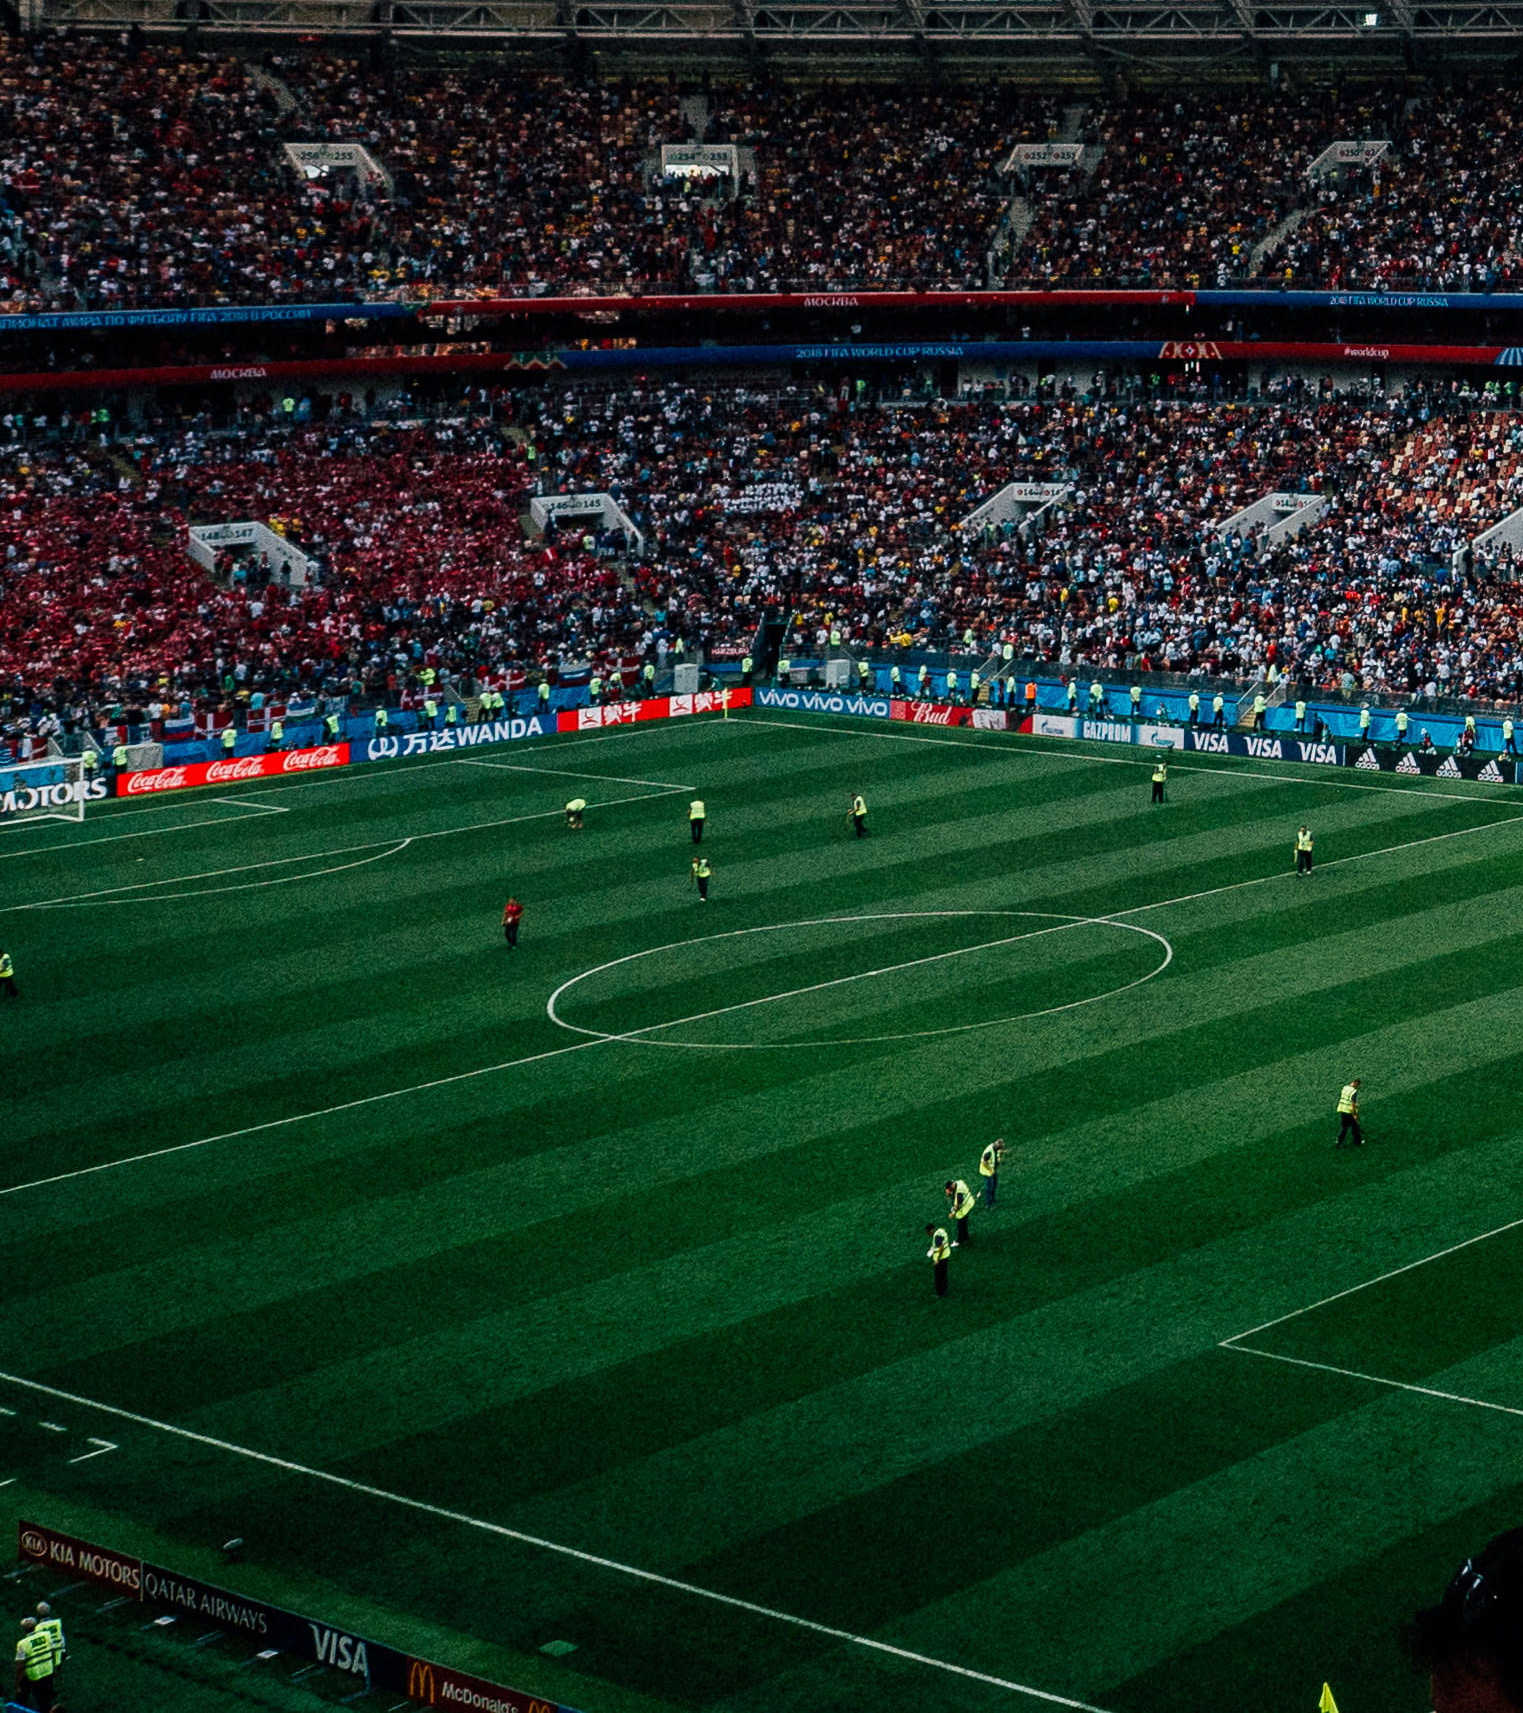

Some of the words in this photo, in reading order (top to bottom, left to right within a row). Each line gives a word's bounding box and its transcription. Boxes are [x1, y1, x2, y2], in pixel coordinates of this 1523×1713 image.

[105, 314, 124, 326] ПО
[759, 689, 799, 708] vivo
[802, 693, 843, 713] vivo
[847, 697, 887, 717] vivo
[911, 701, 952, 725] Bud
[403, 728, 455, 756] 万达
[456, 716, 543, 747] WANDA
[1083, 720, 1131, 743] GAZPROM
[1192, 732, 1229, 754] VISA
[1244, 737, 1283, 759] VISA
[1299, 742, 1337, 765] VISA
[24, 1535, 44, 1552] KIA
[50, 1540, 75, 1566] KIA
[79, 1552, 141, 1590] MOTORS
[146, 1573, 198, 1610] QATAR
[200, 1593, 268, 1635] AIRWAYS
[308, 1623, 369, 1677] VISA
[441, 1681, 520, 1713] McDonald's
